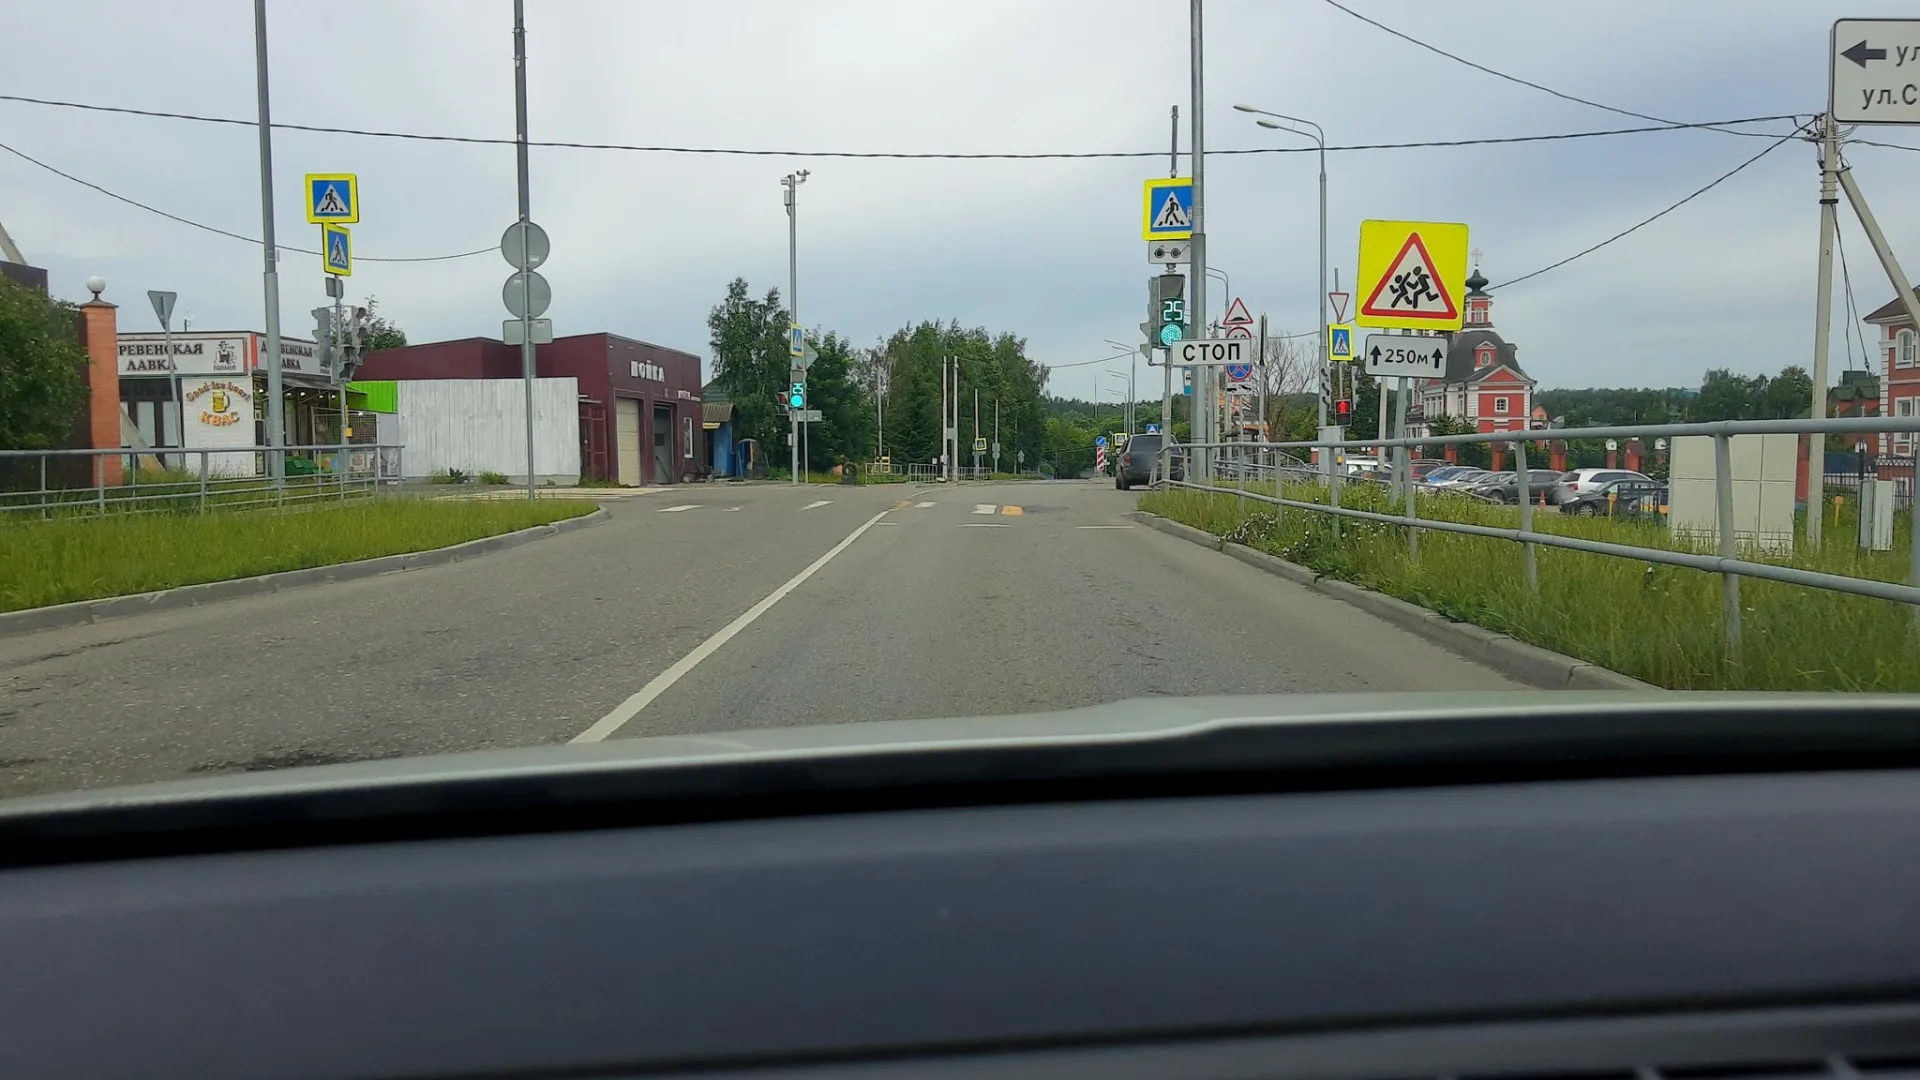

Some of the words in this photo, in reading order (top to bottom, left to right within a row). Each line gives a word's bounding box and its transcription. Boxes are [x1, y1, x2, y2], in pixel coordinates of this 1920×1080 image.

[1163, 301, 1183, 321] 25
[119, 342, 204, 356] РЕВЕНСКАЯ
[260, 341, 313, 357] ДВЕНСКАЯ
[1183, 343, 1240, 361] СТОП
[1384, 348, 1428, 365] 250м
[281, 357, 301, 370] АВКА
[200, 410, 240, 426] КВАС
